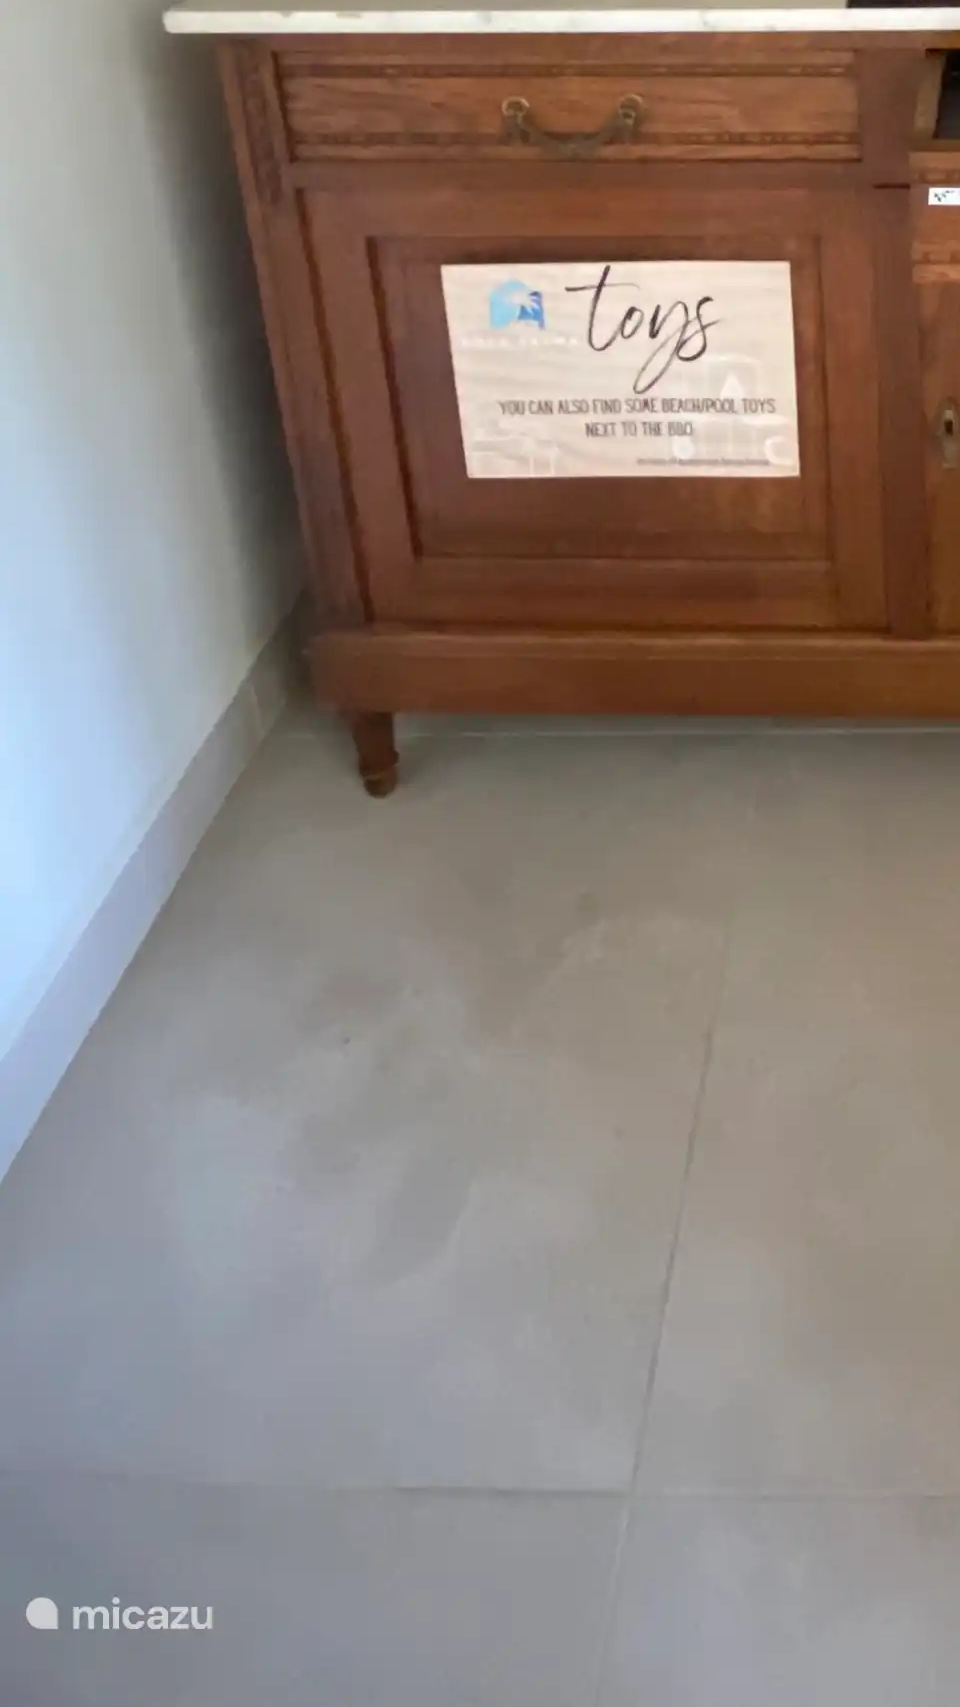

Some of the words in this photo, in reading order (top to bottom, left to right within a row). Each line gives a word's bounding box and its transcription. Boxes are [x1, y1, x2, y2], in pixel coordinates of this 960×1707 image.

[565, 265, 723, 395] toys
[499, 399, 525, 415] YOU
[528, 399, 553, 415] CAN
[558, 398, 589, 414] ALSO
[592, 398, 622, 414] FIND
[624, 398, 658, 413] SOME
[742, 398, 776, 413] TOYS
[585, 422, 616, 438] NEXT
[621, 421, 638, 436] TO
[641, 421, 662, 436] THE
